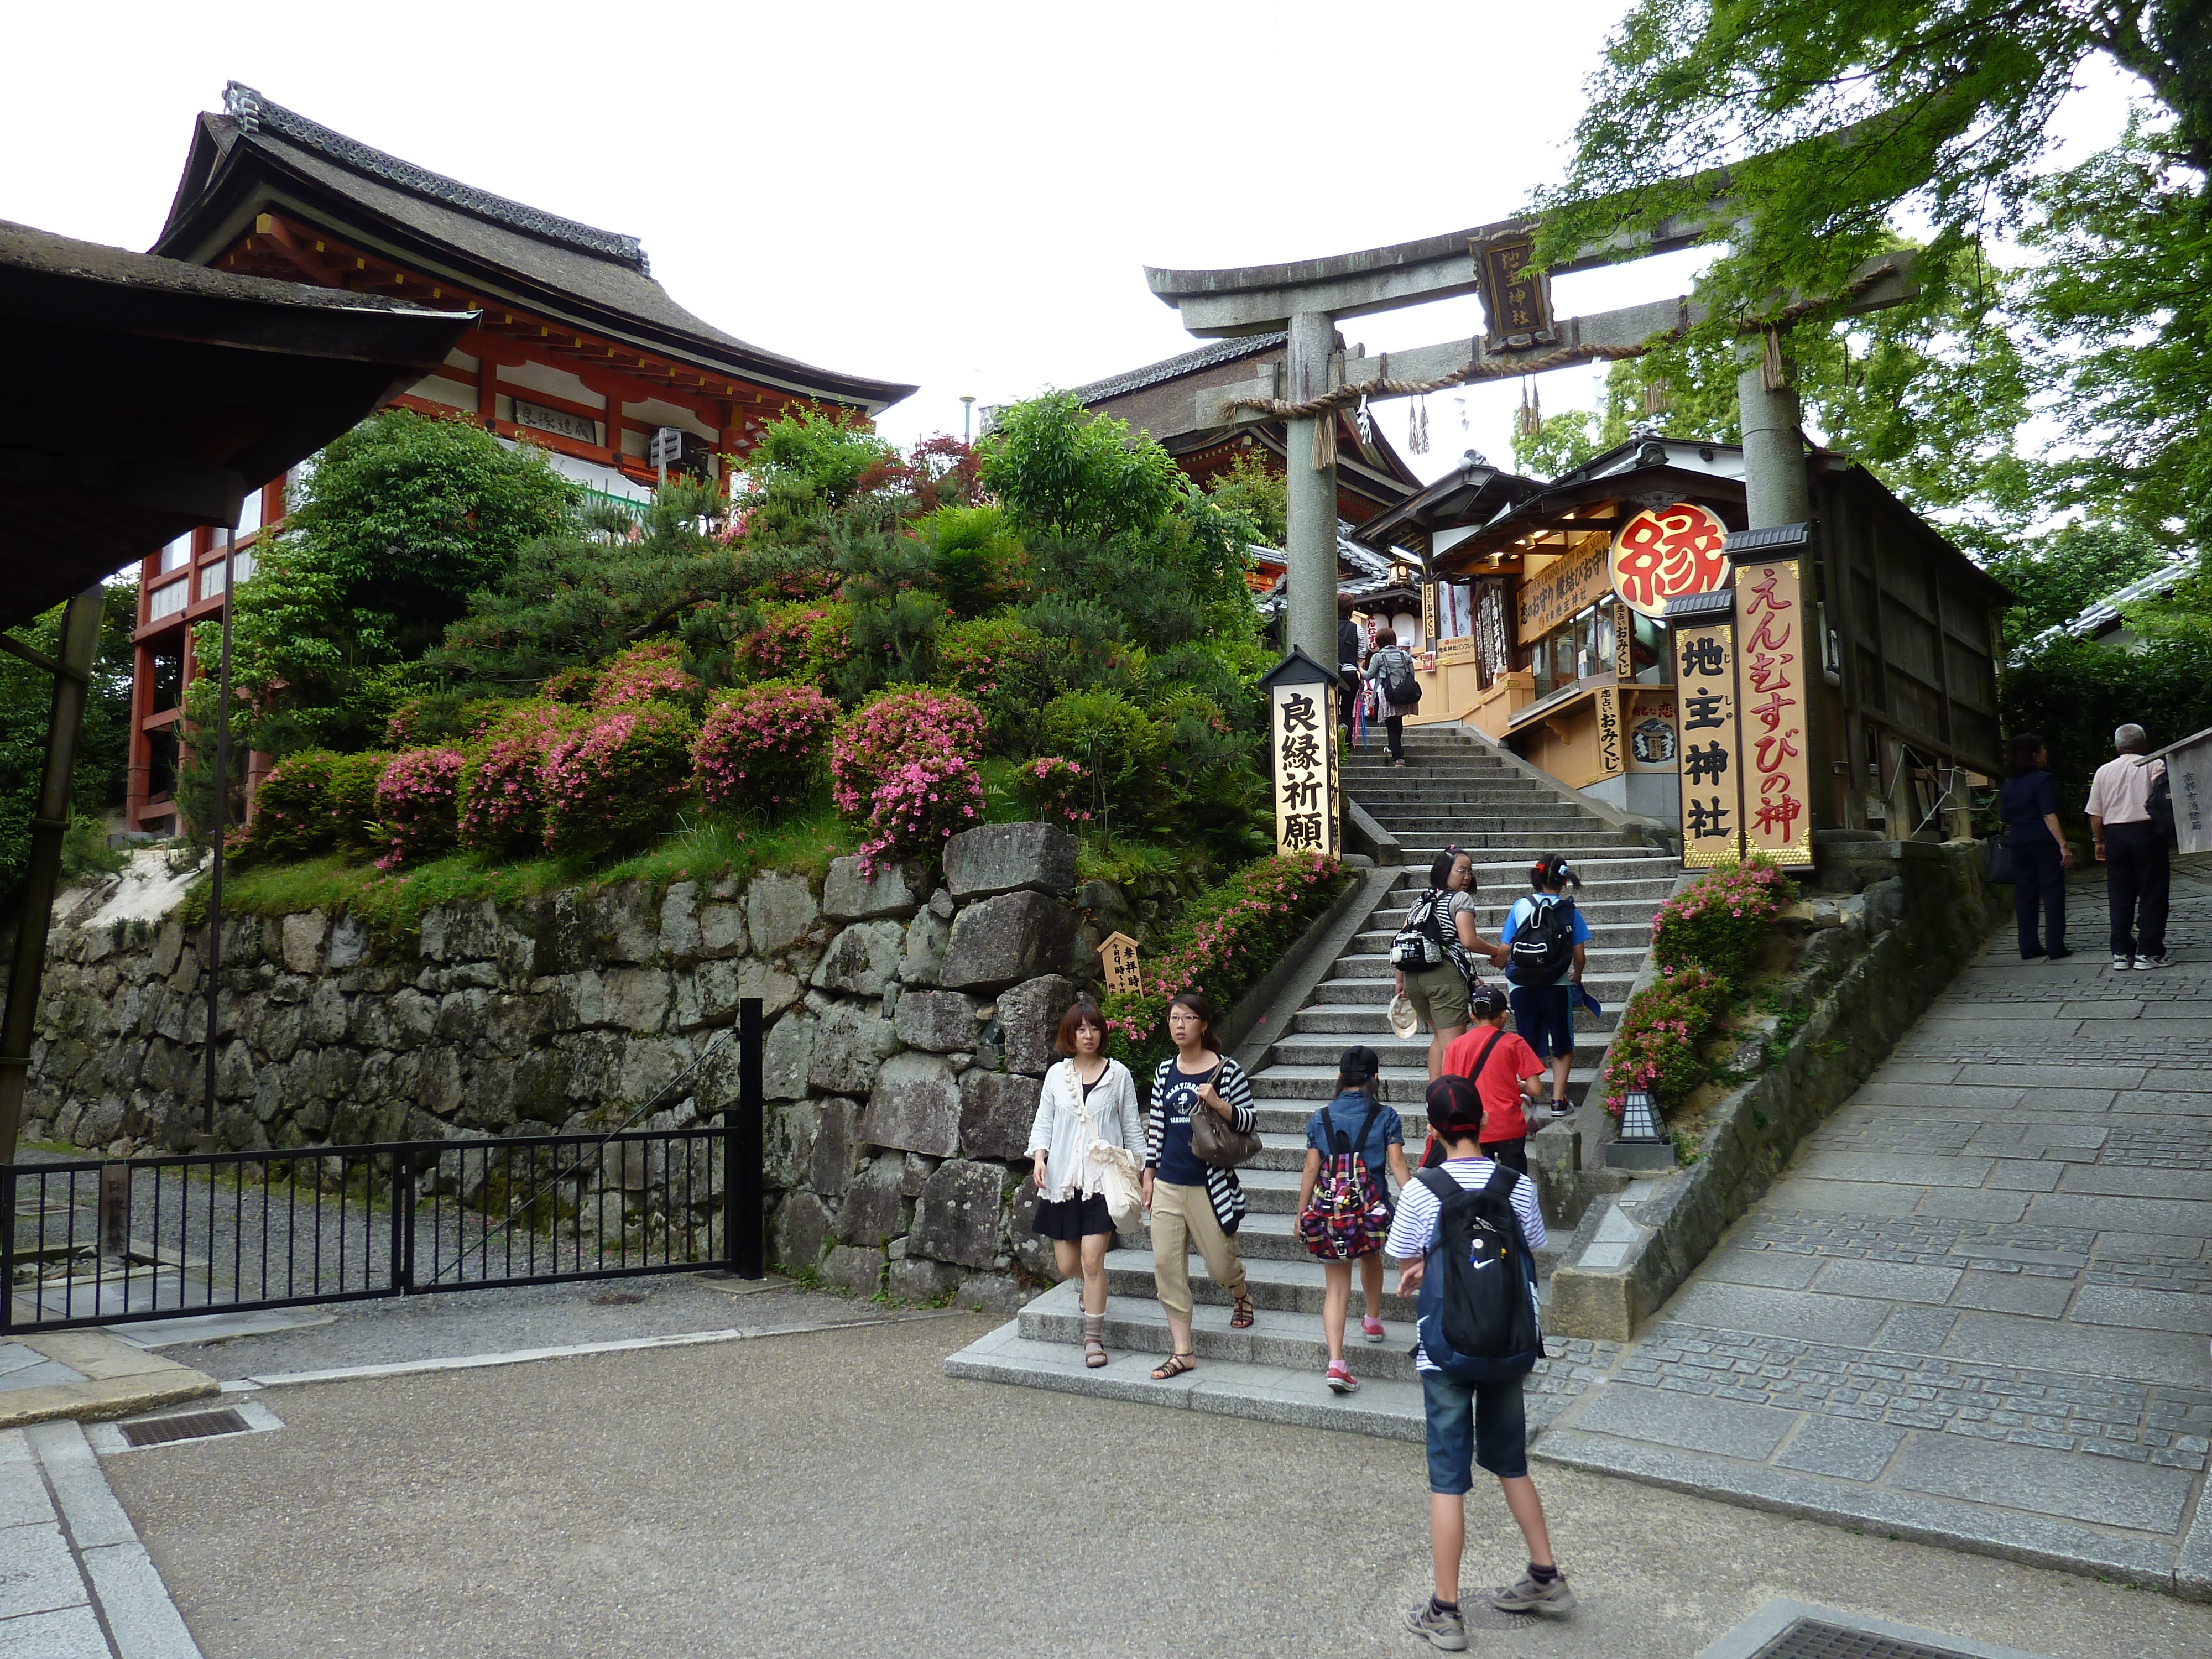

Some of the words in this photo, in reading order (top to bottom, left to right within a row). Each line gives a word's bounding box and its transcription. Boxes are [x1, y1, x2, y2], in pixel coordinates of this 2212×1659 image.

[1501, 251, 1530, 326] 地主神社
[1530, 581, 1540, 593] LUCK
[1542, 566, 1559, 585] CHARMS
[1618, 505, 1724, 606] 縁
[1681, 637, 1733, 839] 地主神社
[1746, 568, 1801, 843] えんむすびの神
[1281, 692, 1323, 851] 良縁祈願
